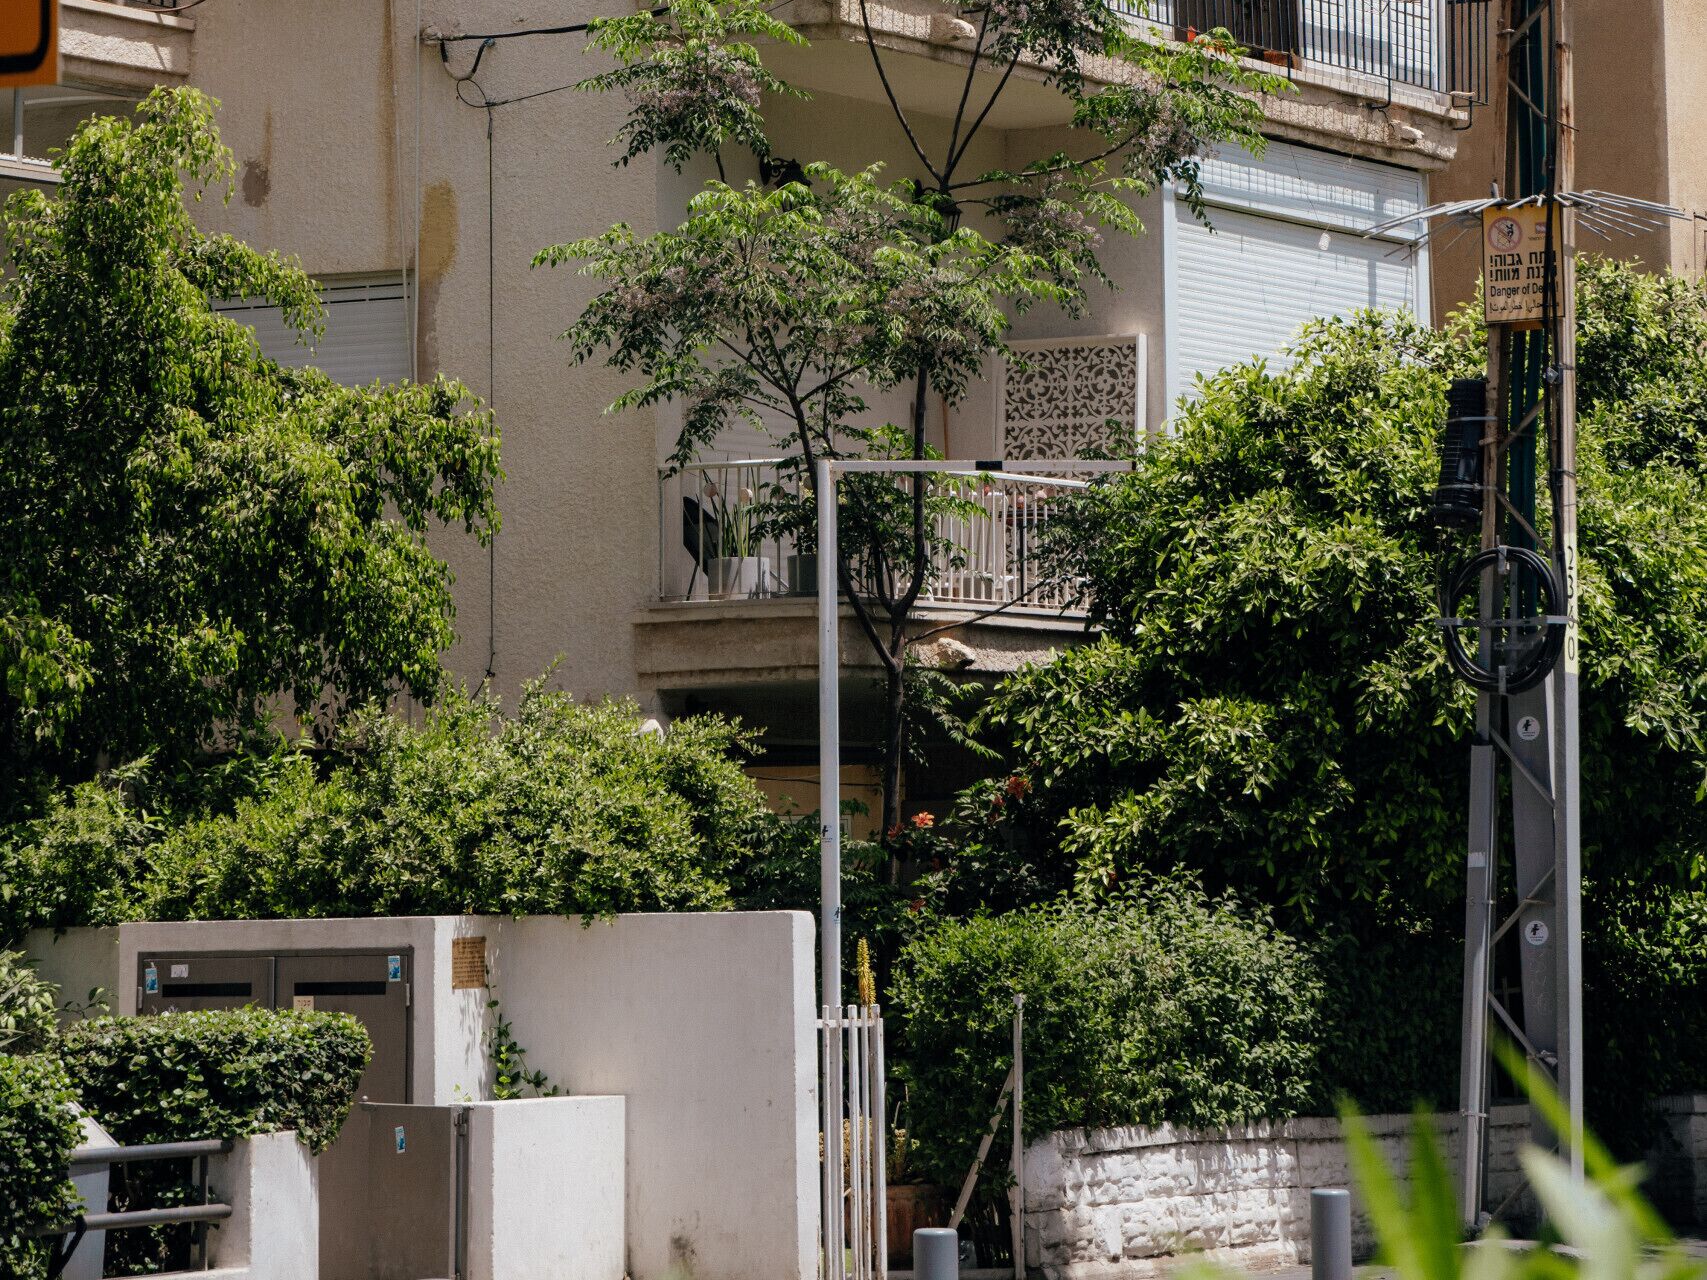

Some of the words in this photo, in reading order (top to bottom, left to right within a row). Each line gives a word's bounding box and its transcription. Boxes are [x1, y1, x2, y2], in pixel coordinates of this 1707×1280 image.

[1490, 253, 1523, 267] גבוה!
[1529, 251, 1556, 264] תח
[1490, 268, 1520, 282] מוות!
[1490, 285, 1520, 298] Danger
[1522, 283, 1530, 295] of
